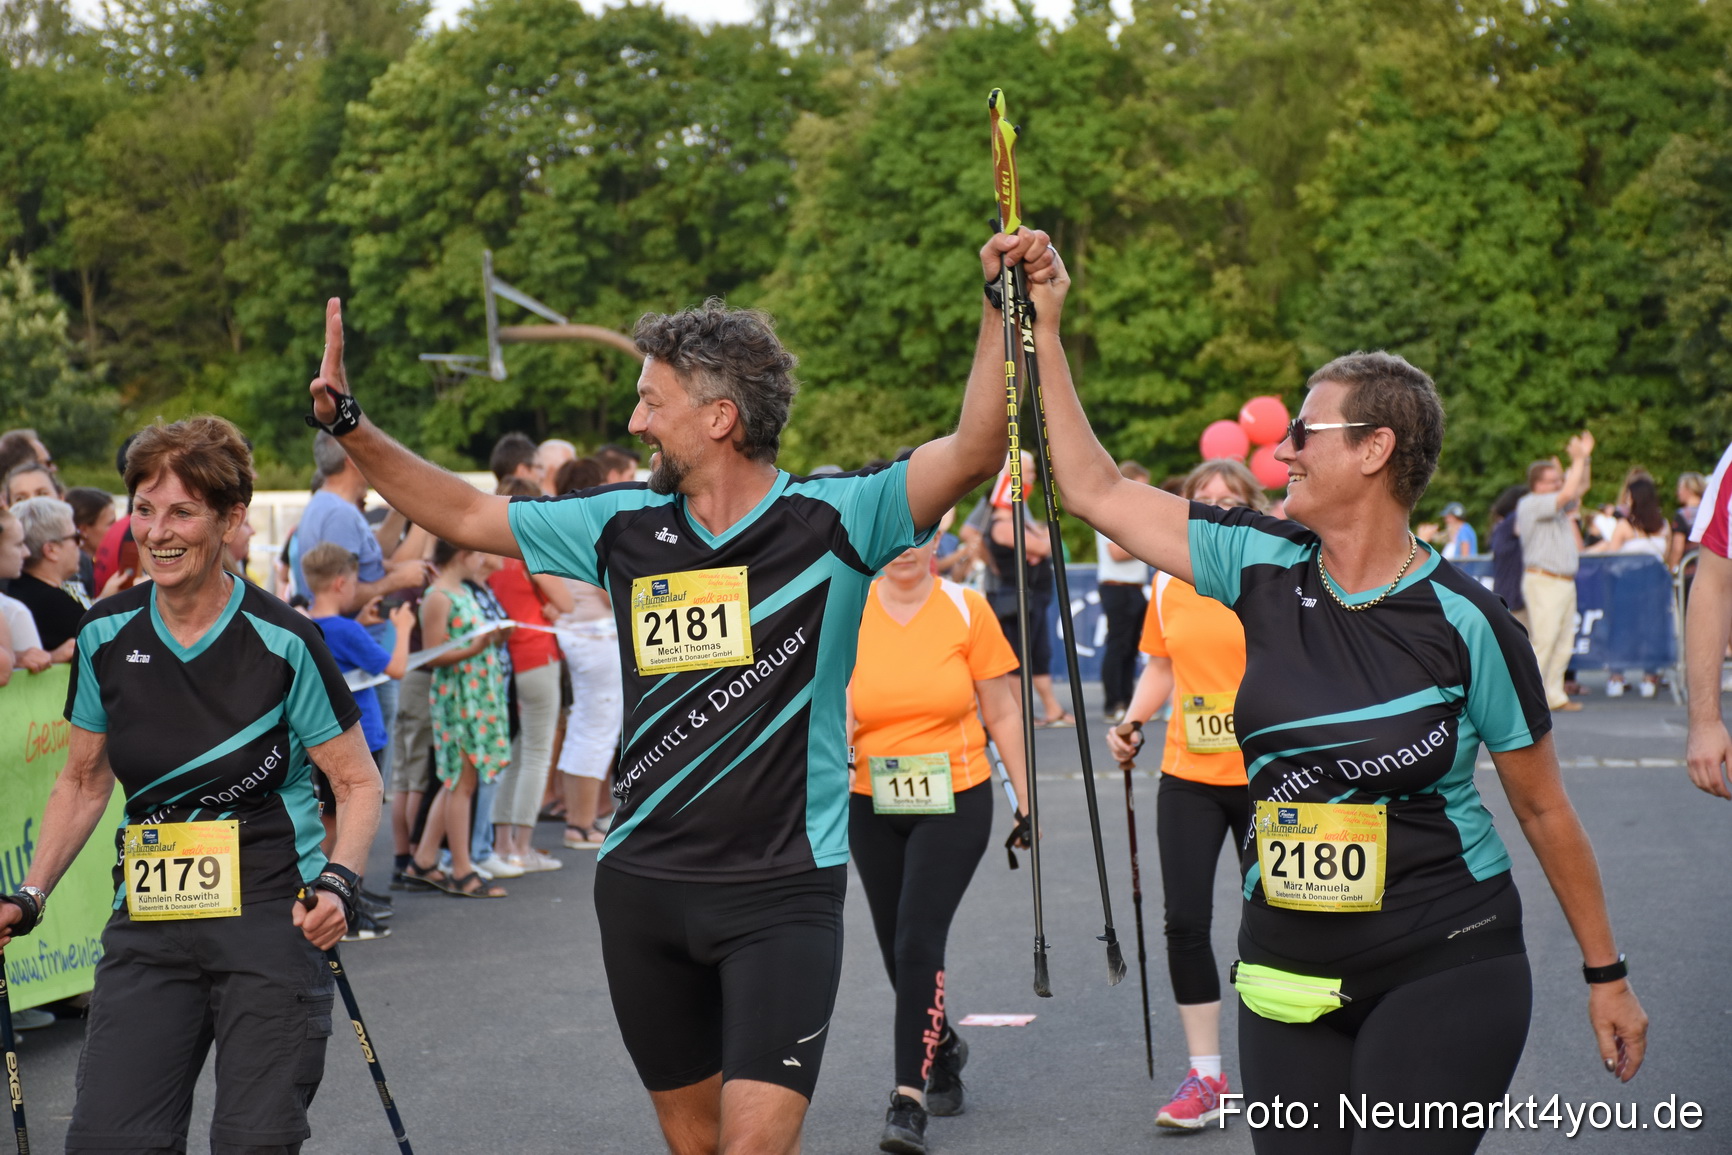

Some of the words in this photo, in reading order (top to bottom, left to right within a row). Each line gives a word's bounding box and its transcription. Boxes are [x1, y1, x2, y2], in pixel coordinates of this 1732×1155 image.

[1002, 170, 1011, 206] LEKI
[1004, 360, 1017, 417] ELITE
[1008, 422, 1022, 503] CARBON
[645, 591, 687, 605] firmenlauf
[693, 592, 715, 604] walk
[716, 593, 740, 602] 2019
[644, 603, 728, 647] 2181
[650, 656, 678, 665] Siebentritt
[684, 653, 711, 661] Donauer
[712, 650, 733, 659] GmbH
[657, 645, 682, 656] Meckl
[684, 642, 721, 654] Thomas
[688, 709, 709, 728] &
[707, 626, 807, 713] Donauer
[1337, 720, 1450, 781] Donauer
[200, 745, 284, 807] Donauer
[889, 776, 930, 797] 111
[1271, 822, 1319, 835] firmenlauf
[1324, 829, 1350, 842] walk
[1351, 833, 1377, 842] 2019
[1269, 840, 1366, 881] 2180
[134, 856, 221, 893] 2179
[1275, 890, 1301, 899] Siebentritt
[1302, 892, 1307, 900] &
[1308, 893, 1339, 901] Donauer
[1340, 894, 1363, 902] GmbH
[1283, 880, 1303, 891] März
[1305, 882, 1351, 893] Manuela
[138, 894, 172, 904] Kühnlein
[174, 892, 220, 902] Roswitha
[138, 904, 164, 912] Siebentritt
[1462, 914, 1497, 933] BROOKS
